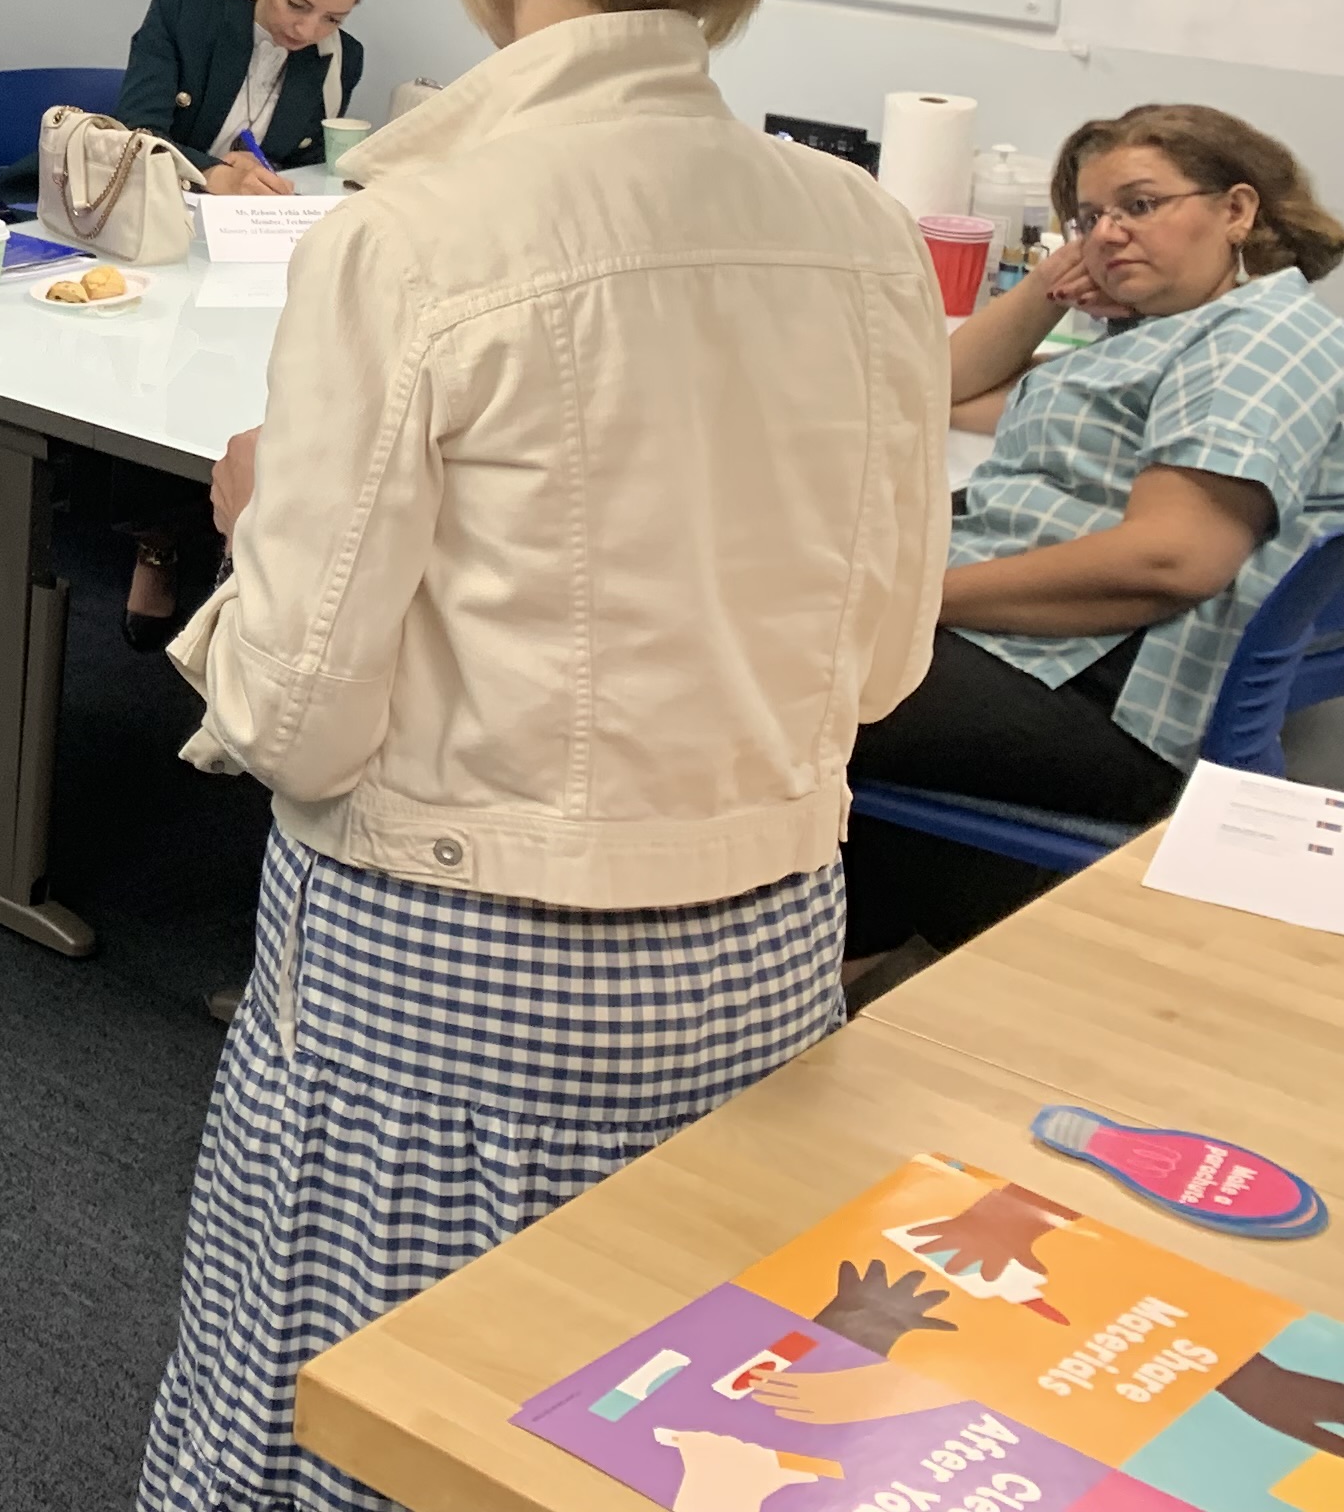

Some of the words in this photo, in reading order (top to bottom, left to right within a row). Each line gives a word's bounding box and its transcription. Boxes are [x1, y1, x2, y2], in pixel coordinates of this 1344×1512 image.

[1178, 1143, 1229, 1205] parachute.
[1221, 1164, 1259, 1196] Make
[1213, 1194, 1234, 1206] a
[1037, 1295, 1190, 1397] Materials
[1115, 1338, 1219, 1404] Share
[919, 1412, 1020, 1483] After
[851, 1480, 942, 1512] Yo
[946, 1473, 1043, 1512] Cle
